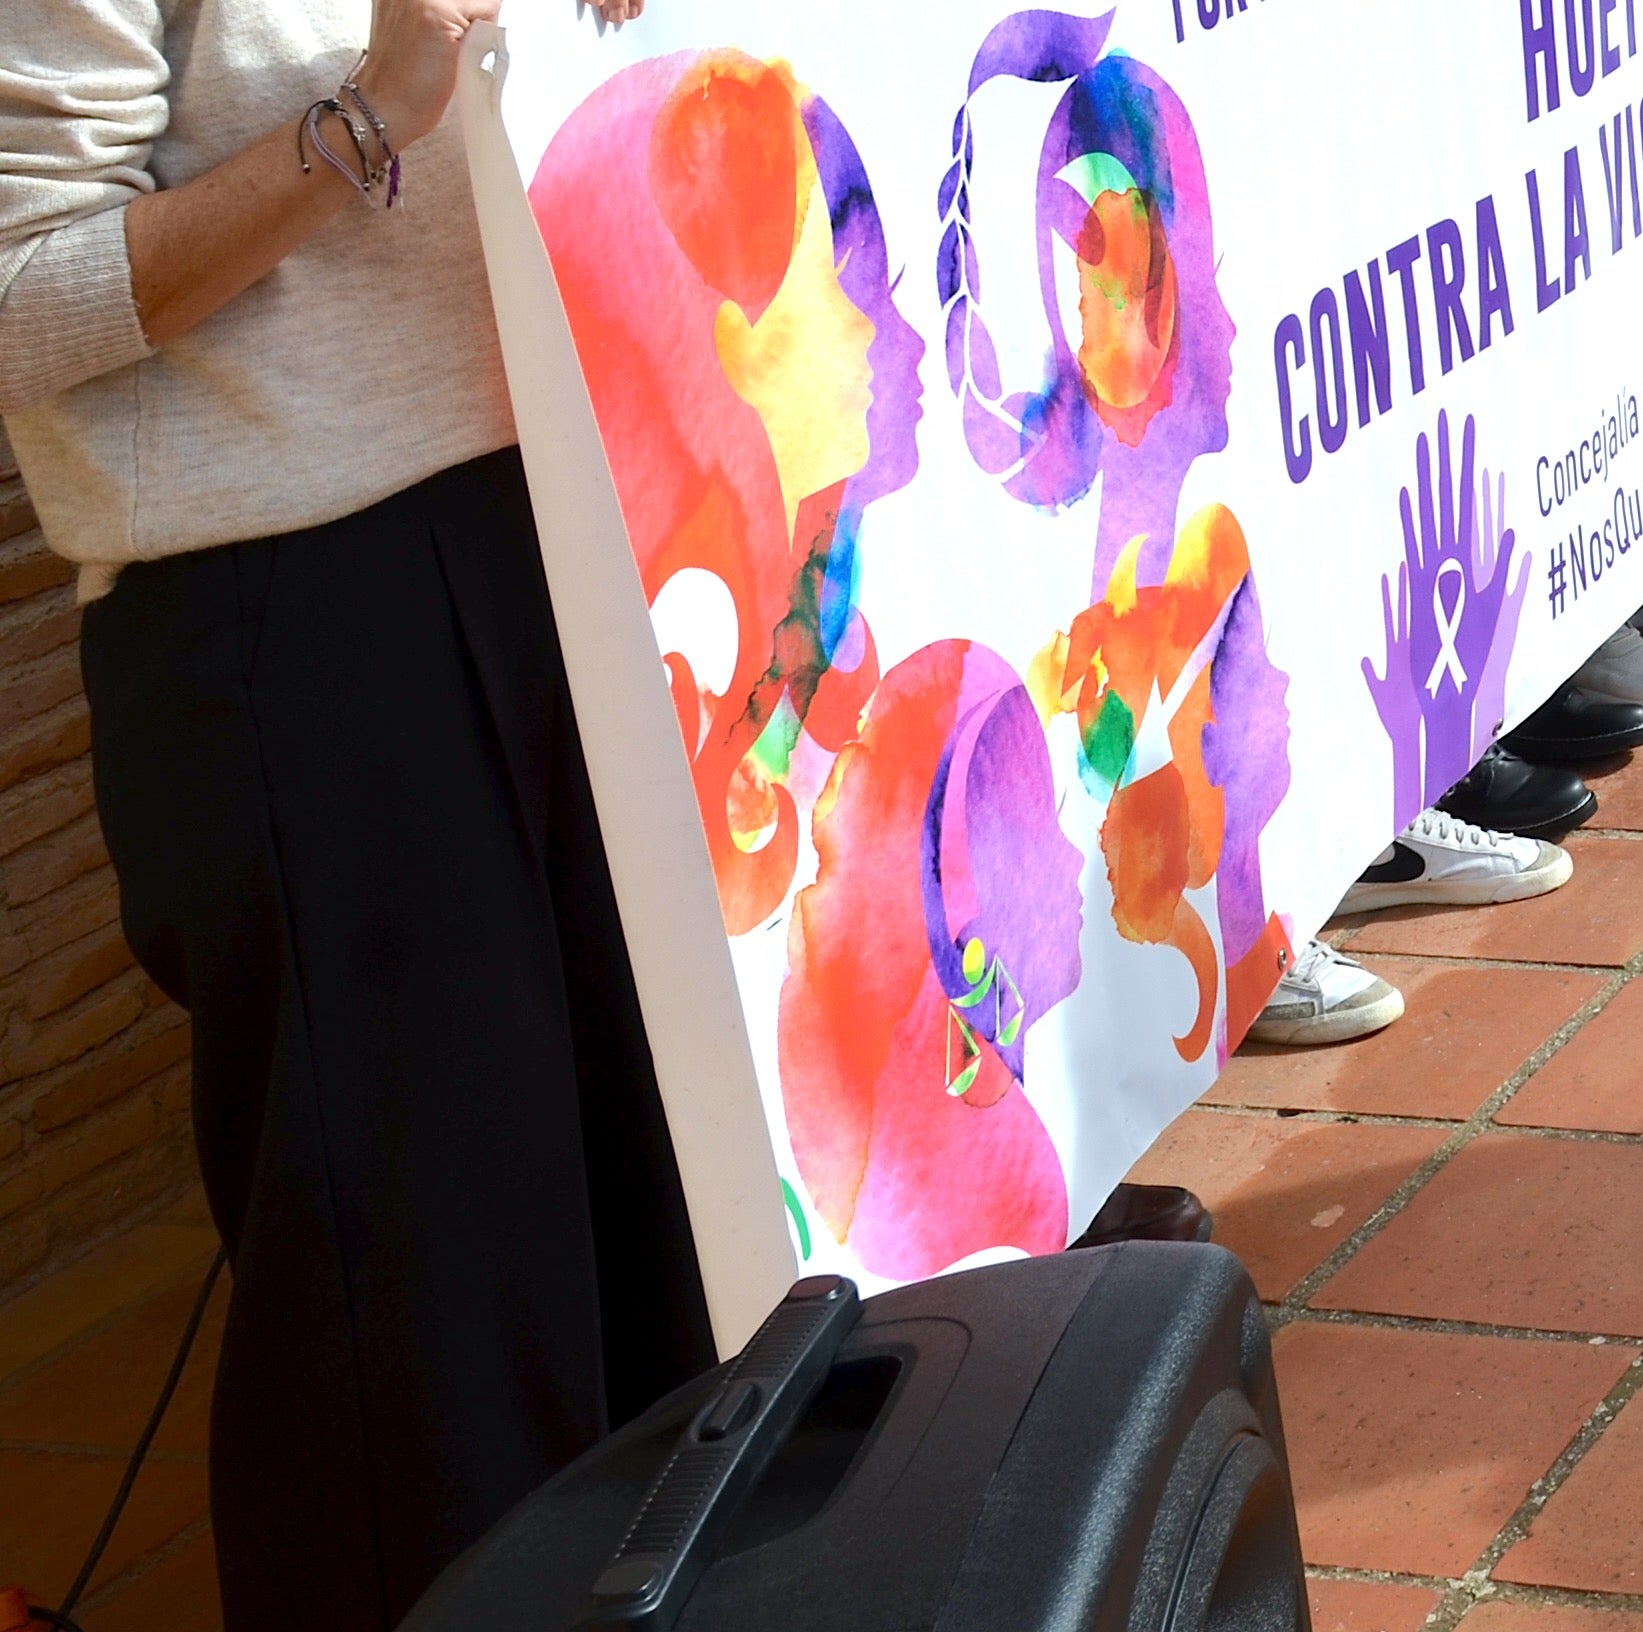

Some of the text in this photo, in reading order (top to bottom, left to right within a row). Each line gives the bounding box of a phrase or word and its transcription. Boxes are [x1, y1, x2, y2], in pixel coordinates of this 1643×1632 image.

[1274, 194, 1514, 484] CONTRA
[1525, 146, 1591, 314] LA
[1537, 385, 1640, 518] Concejalía
